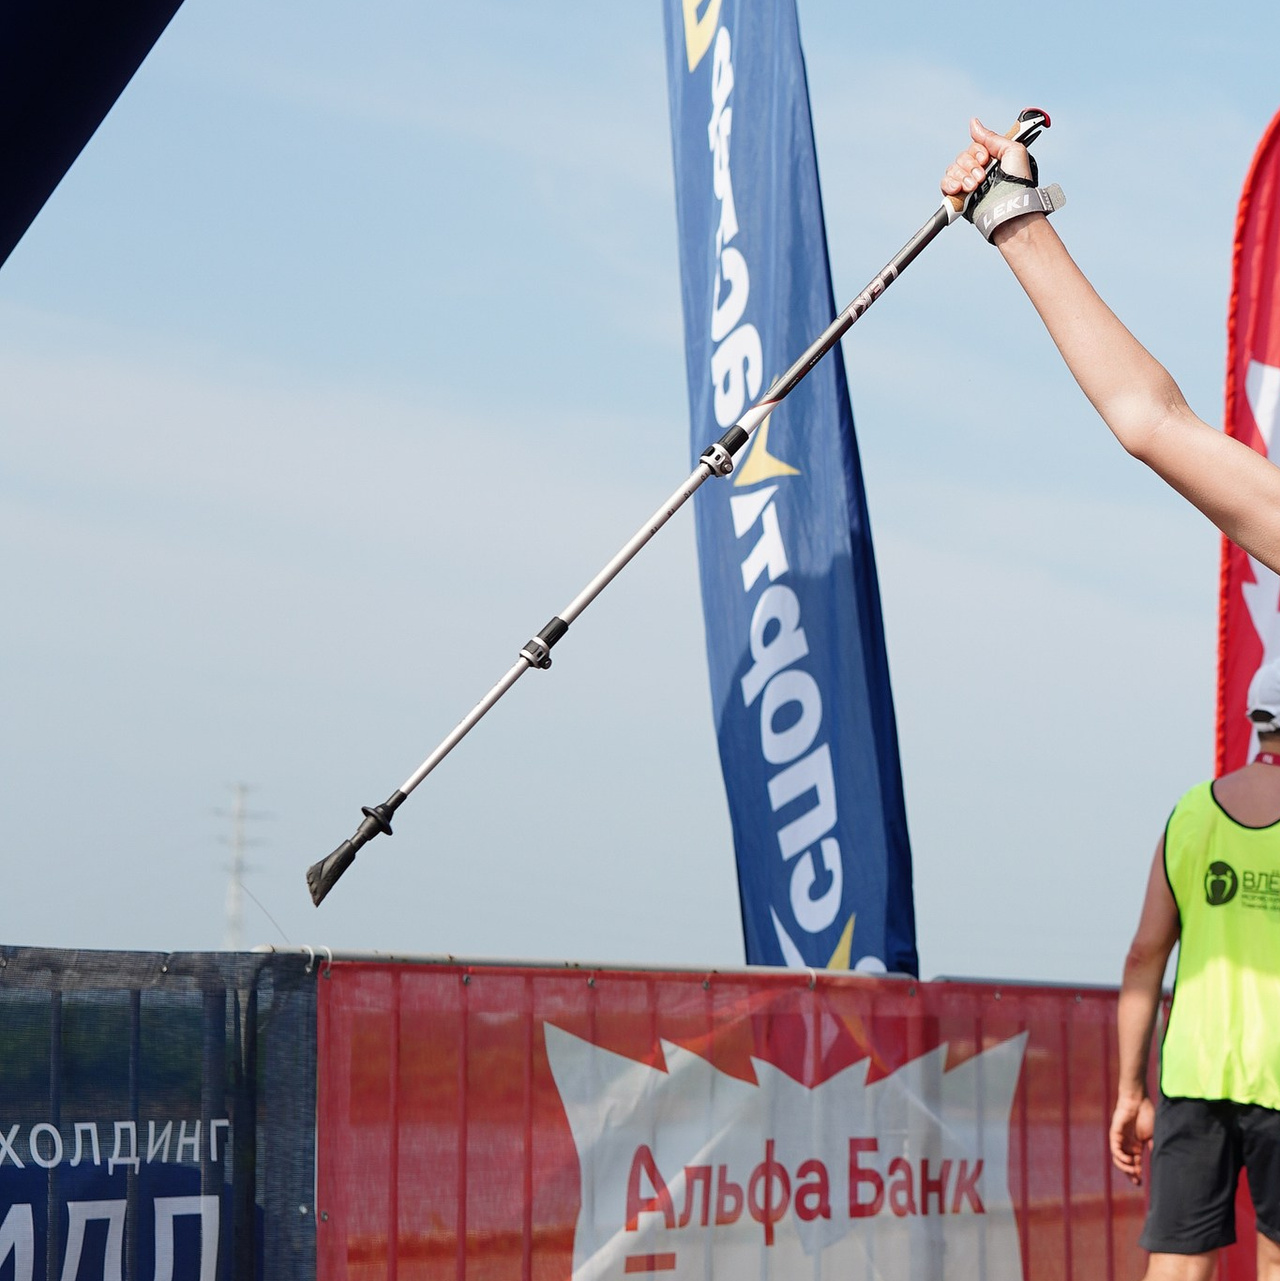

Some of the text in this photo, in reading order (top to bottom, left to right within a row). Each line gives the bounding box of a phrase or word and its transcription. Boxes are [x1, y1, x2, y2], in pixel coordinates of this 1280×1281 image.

[982, 194, 1030, 230] LEKI
[625, 1136, 986, 1250] Альфа Банк
